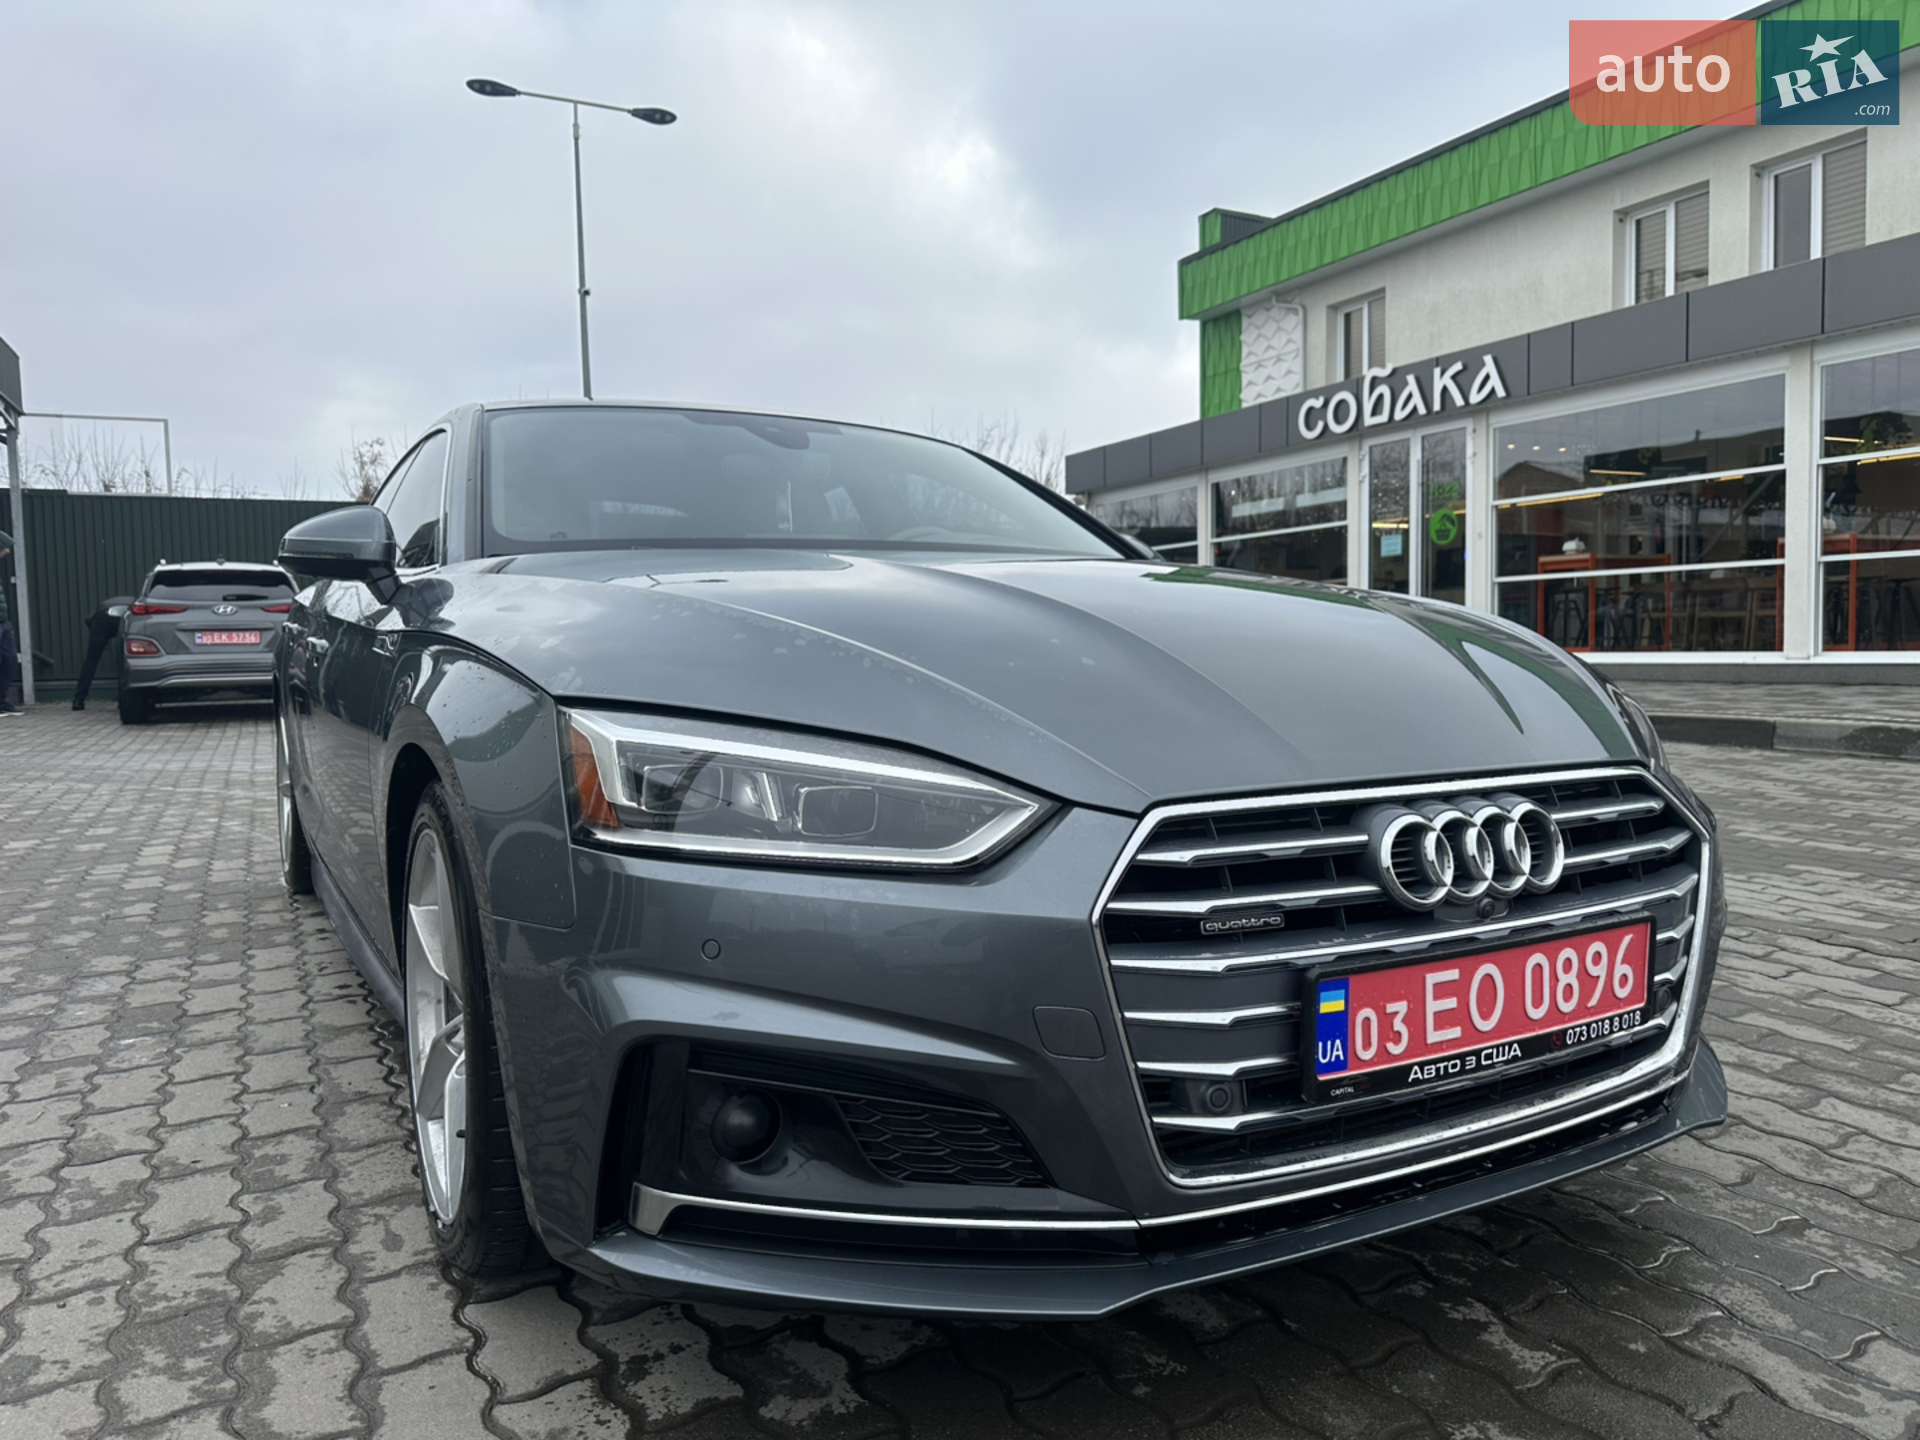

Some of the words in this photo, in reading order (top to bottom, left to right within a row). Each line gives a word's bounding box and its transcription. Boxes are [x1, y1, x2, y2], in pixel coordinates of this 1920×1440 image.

[1205, 916, 1281, 932] quattro
[1354, 1001, 1409, 1061] 03
[1525, 934, 1634, 1021] 0896
[1566, 1025, 1588, 1044] 073
[1590, 1019, 1611, 1038] 018
[1612, 1016, 1620, 1032] 8
[1622, 1010, 1641, 1029] 018
[1318, 1039, 1345, 1064] UA
[1480, 1042, 1522, 1066] США
